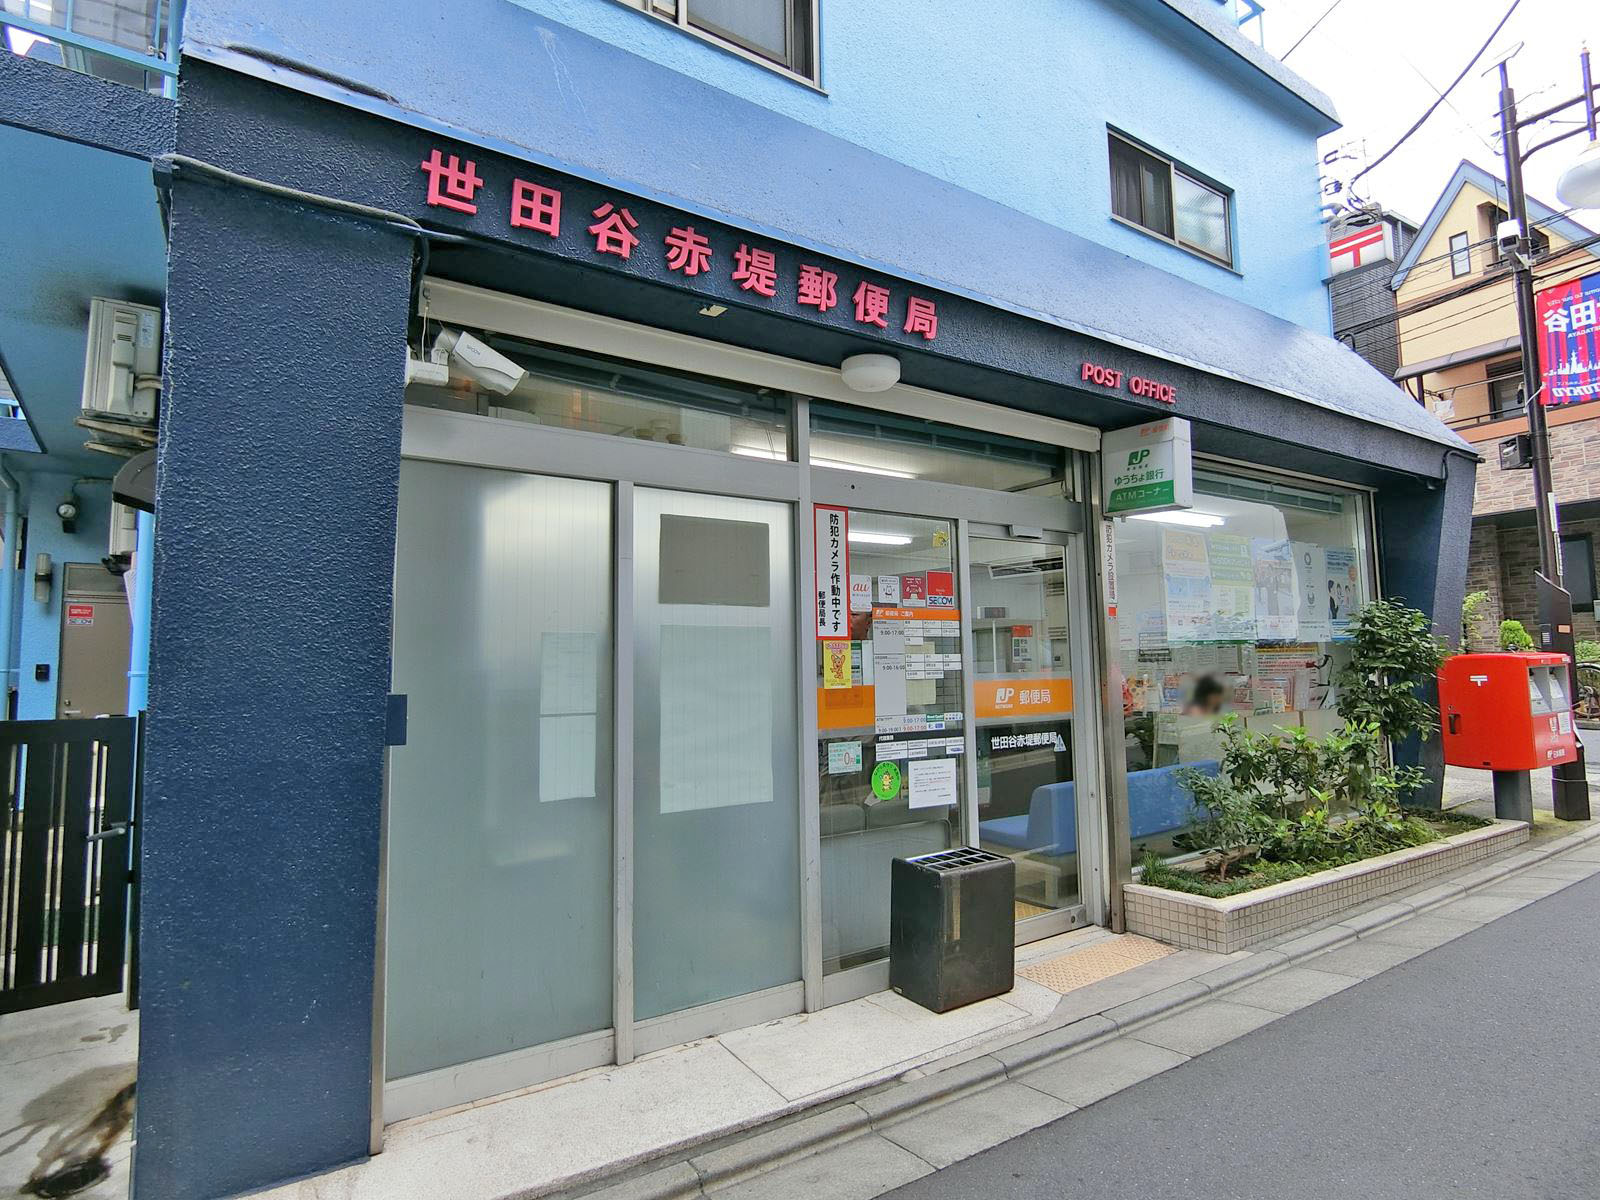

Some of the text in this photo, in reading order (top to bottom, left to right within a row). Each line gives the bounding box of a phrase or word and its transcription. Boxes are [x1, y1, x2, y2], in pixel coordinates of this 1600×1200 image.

[421, 148, 938, 340] 世田谷赤堤郵便局
[1082, 362, 1176, 404] POST OFFICE
[1114, 468, 1164, 486] ゆうちょ銀行
[1116, 487, 1169, 501] ATMコーナー
[829, 513, 841, 632] 防犯カメラ作動中です
[852, 583, 869, 592] au
[818, 591, 826, 627] 郵便局長
[928, 596, 953, 605] SECOM
[1019, 689, 1051, 705] 郵便局
[991, 732, 1057, 750] 世田谷赤堤郵便局
